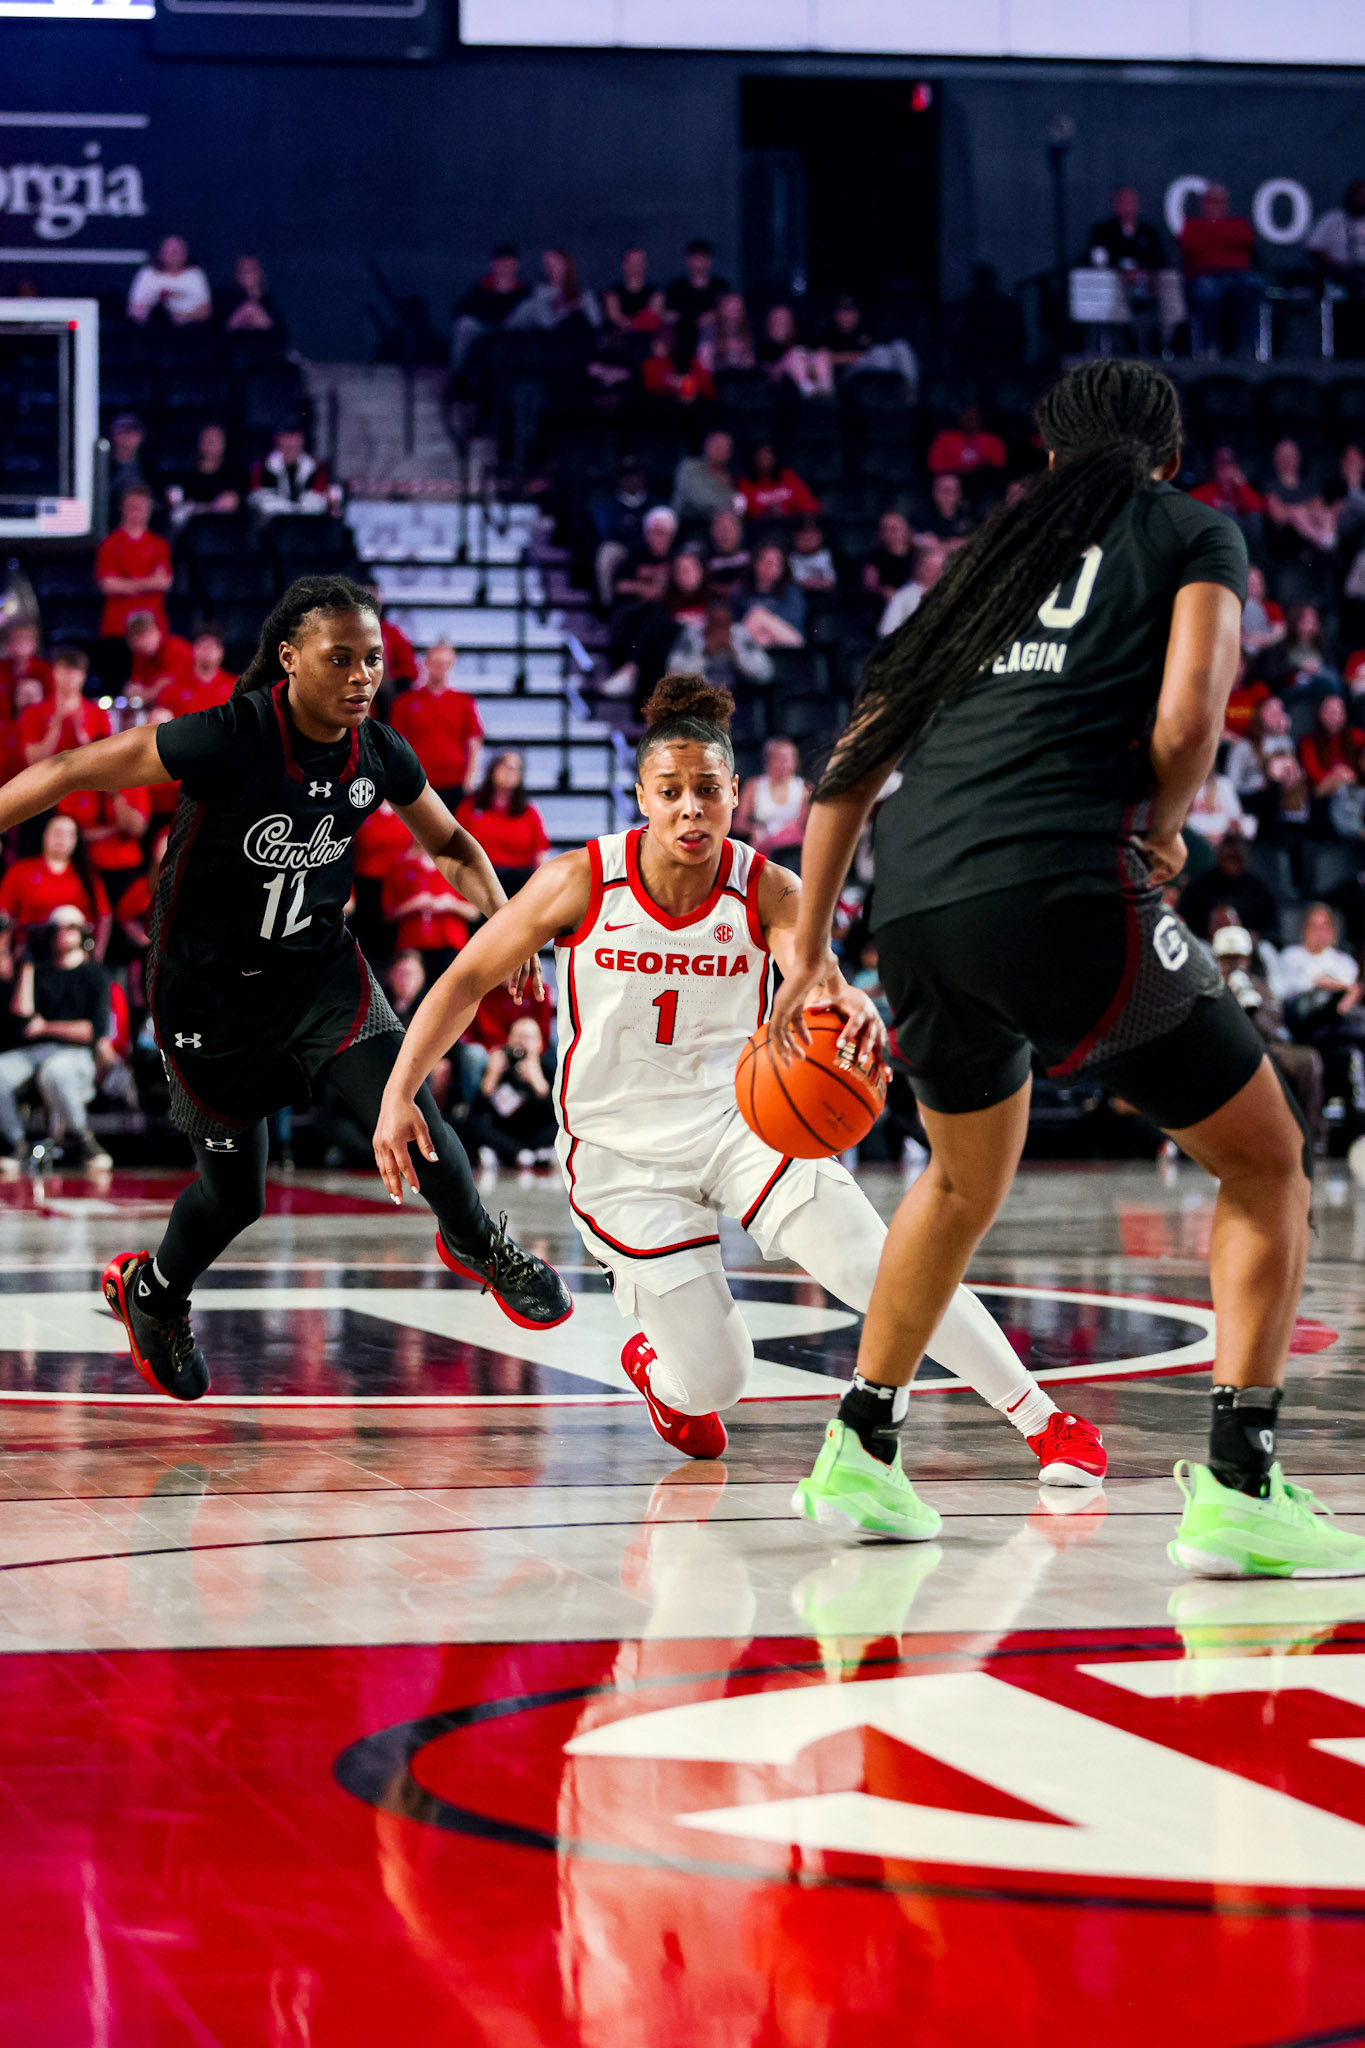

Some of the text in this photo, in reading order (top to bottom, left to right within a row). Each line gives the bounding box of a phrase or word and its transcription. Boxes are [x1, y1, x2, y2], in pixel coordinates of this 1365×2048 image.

[978, 641, 1067, 674] EAGIN
[350, 778, 375, 808] SEC
[243, 814, 352, 869] Carolina
[260, 870, 312, 940] 12
[714, 923, 734, 943] SEC
[594, 948, 749, 976] GEORGIA
[652, 989, 679, 1046] 1
